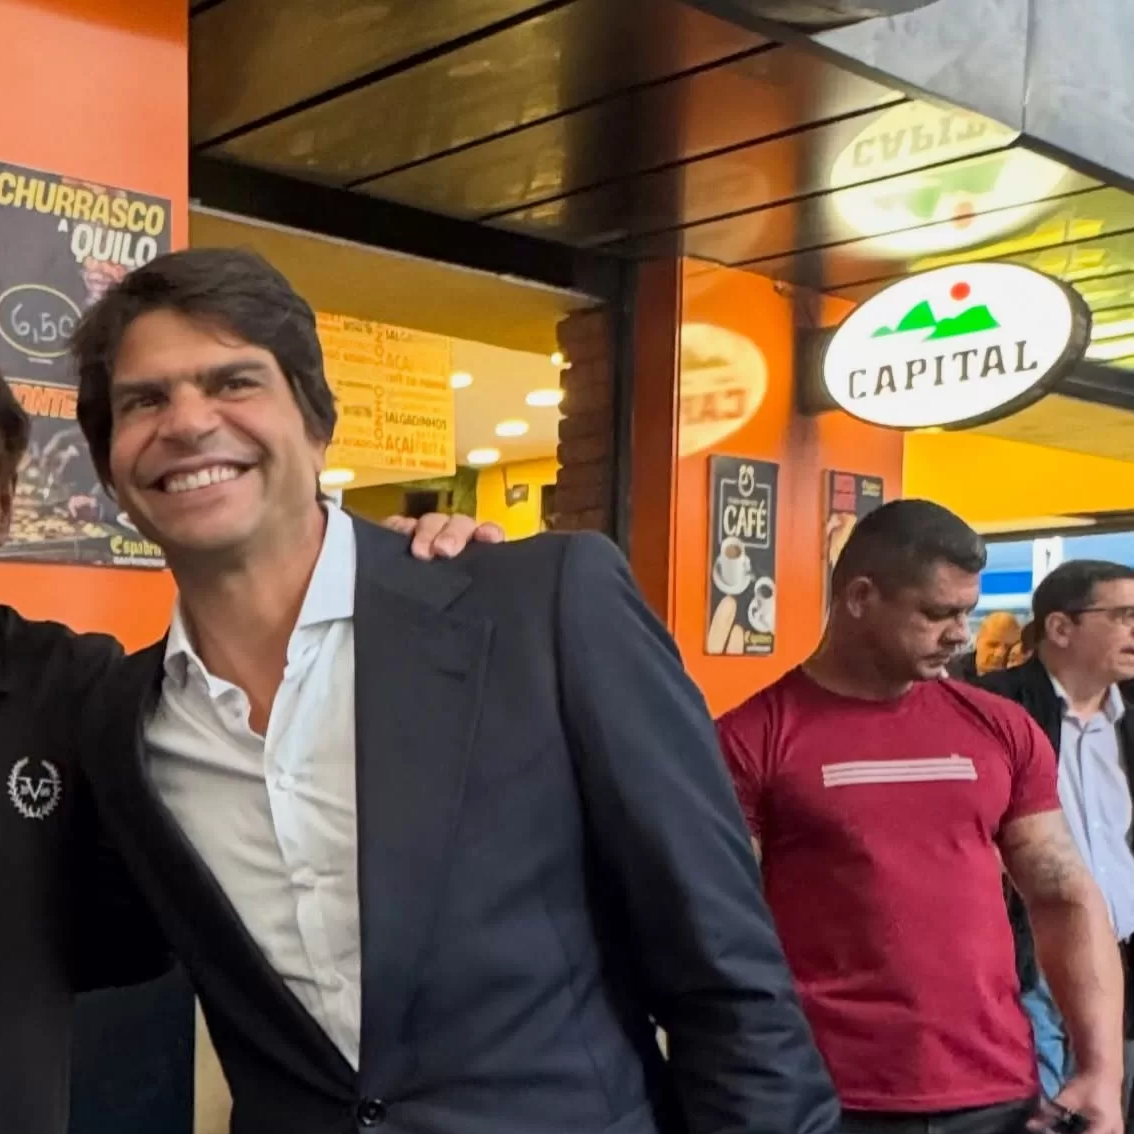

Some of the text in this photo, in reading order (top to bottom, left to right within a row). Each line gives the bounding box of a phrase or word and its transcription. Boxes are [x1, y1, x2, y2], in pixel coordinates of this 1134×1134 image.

[70, 222, 158, 268] QUILO
[848, 340, 1038, 399] CAPITAL
[723, 502, 767, 538] CAFÉ
